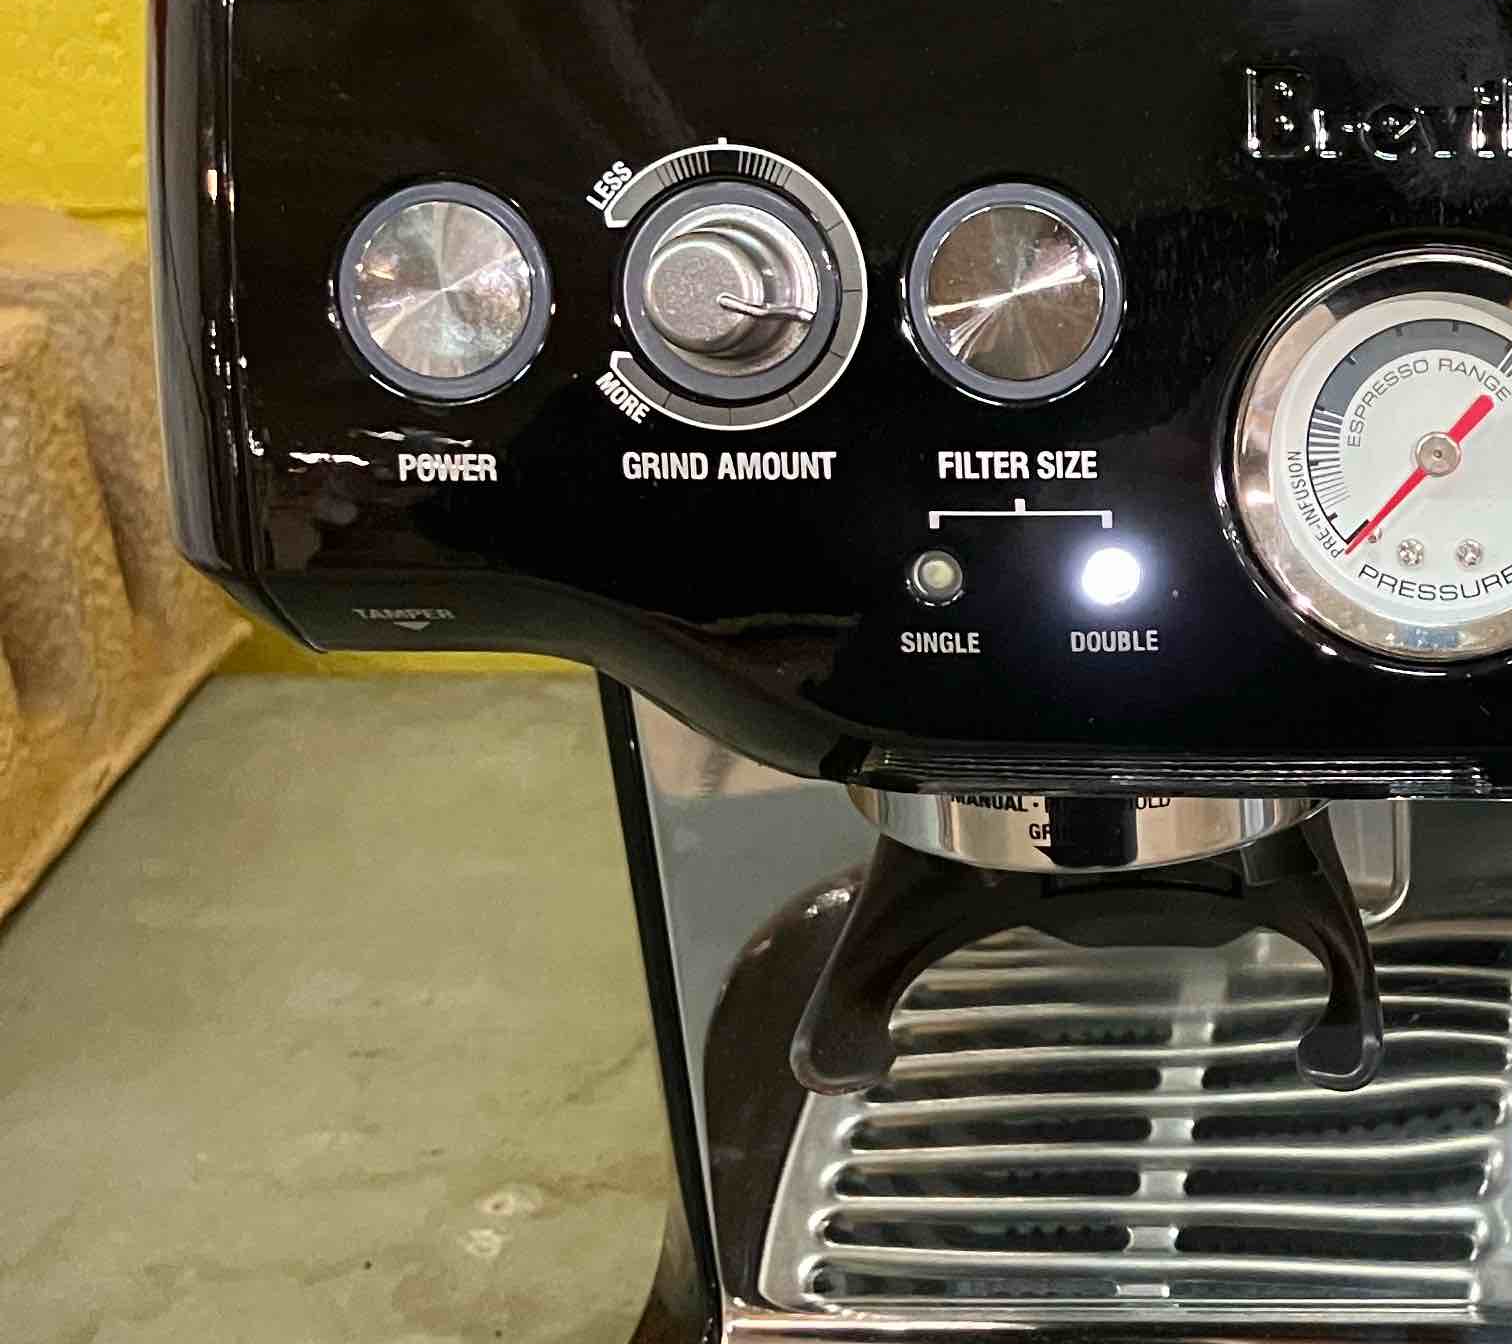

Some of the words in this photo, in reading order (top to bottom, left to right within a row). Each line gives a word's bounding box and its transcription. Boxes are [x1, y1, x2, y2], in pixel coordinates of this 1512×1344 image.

[586, 160, 633, 211] LESS
[595, 371, 650, 424] MORE
[1347, 359, 1429, 447] ESPRESSO
[1438, 358, 1512, 401] RANGE
[398, 454, 498, 483] POWER
[621, 452, 709, 481] GRIND
[717, 452, 837, 481] AMOUNT
[938, 452, 1029, 480] FILTER
[1038, 452, 1098, 480] SIZE
[1286, 451, 1345, 558] PRE-INFUSION
[352, 608, 456, 621] TAMPER
[900, 632, 981, 654] SINGLE
[1070, 630, 1159, 652] DOUBLE
[951, 794, 1028, 812] MANUAL
